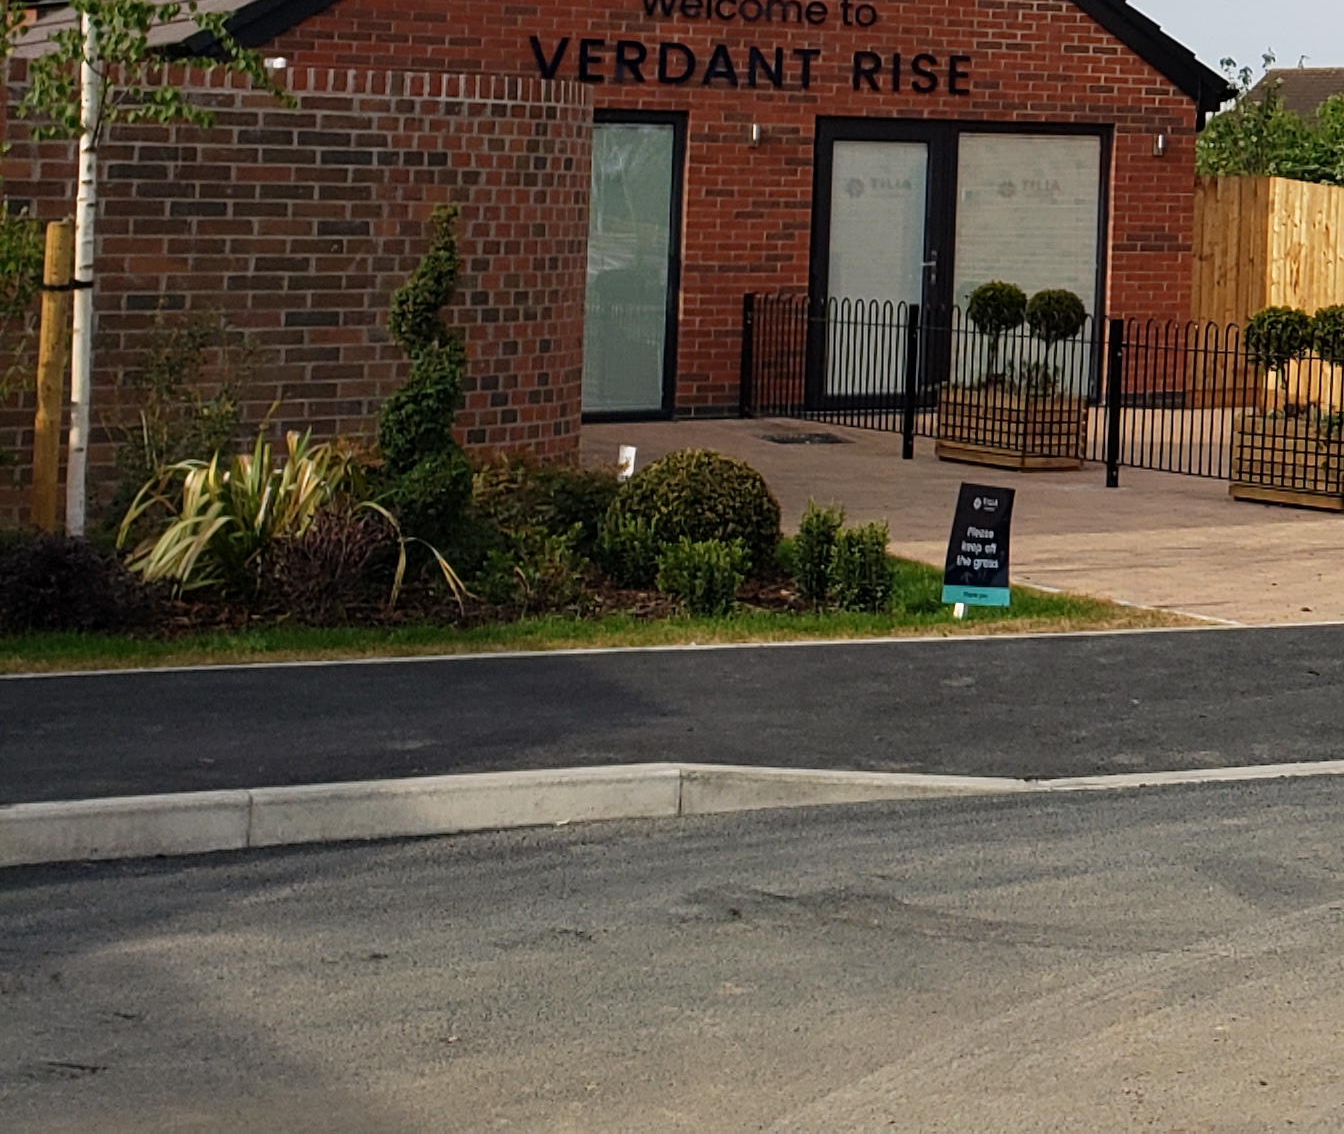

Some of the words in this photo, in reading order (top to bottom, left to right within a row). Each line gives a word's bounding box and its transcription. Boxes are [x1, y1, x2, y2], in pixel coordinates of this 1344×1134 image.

[529, 35, 821, 90] VERDANT
[852, 50, 972, 96] RISE
[869, 177, 912, 192] TILIA
[1021, 178, 1061, 193] TILIA
[956, 554, 972, 567] the
[973, 558, 999, 571] grass
